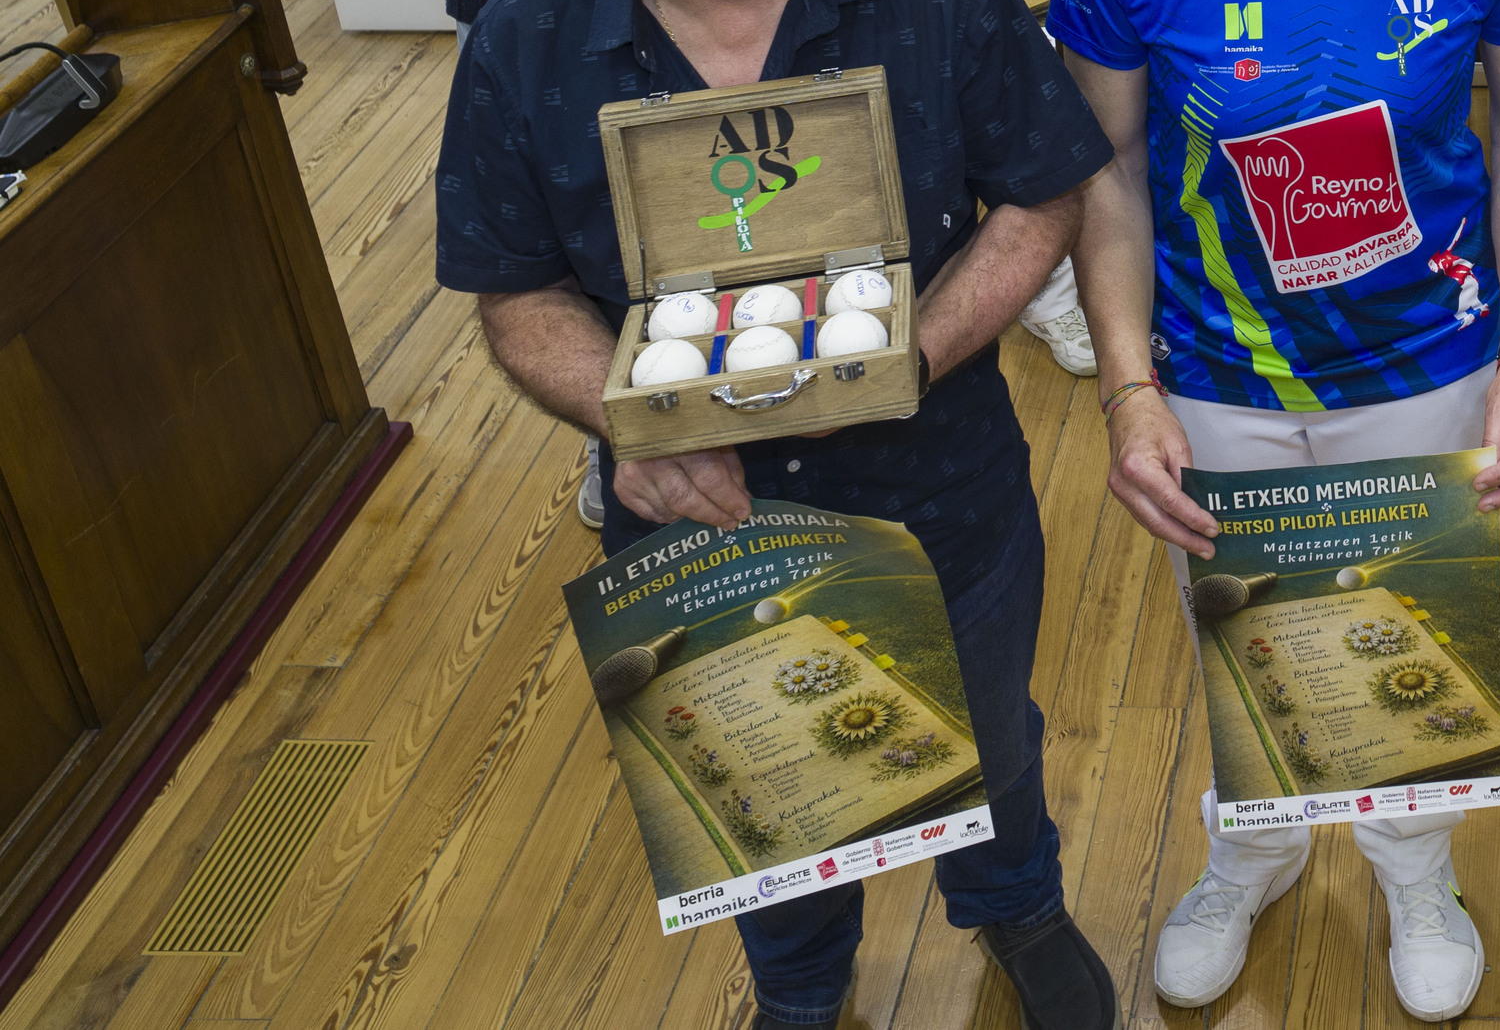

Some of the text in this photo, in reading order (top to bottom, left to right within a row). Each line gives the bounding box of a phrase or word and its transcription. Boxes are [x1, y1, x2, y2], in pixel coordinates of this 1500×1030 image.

[1224, 45, 1263, 53] hamaika
[1289, 174, 1402, 225] Gourmet
[1311, 174, 1384, 199] Reyno
[733, 196, 752, 251] PILOTA
[1277, 221, 1414, 277] CALIDAD NAVARRA
[1281, 233, 1420, 290] NAFAR KALITATEA
[1207, 472, 1438, 511] II. ETXEKO MEMORIALA
[1280, 513, 1337, 531] PILOTA
[1341, 502, 1429, 526] LEHIAKETA
[1263, 530, 1413, 553] Maiatzaren 1etik
[1278, 546, 1401, 564] Ekainaren 7ra
[597, 575, 621, 596] II.
[625, 529, 711, 581] ETXEKO
[604, 532, 848, 617] BERTSO PILOTA LEHIAKETA
[665, 551, 833, 607] Maiatzaren 1etik
[683, 565, 823, 614] Ekainaren 7ra
[662, 631, 792, 693] Zure irria hedatu dadin
[708, 663, 740, 680] hauen
[744, 647, 779, 664] artean
[693, 677, 750, 706] Mitxoletak
[724, 712, 783, 742] Bitxiloreak
[751, 749, 817, 784] Eguzkiloreak
[778, 785, 845, 822] Kukuprakak
[1236, 800, 1275, 813] berria
[1236, 813, 1304, 826] hamaika
[765, 868, 811, 887] EULATE
[679, 886, 724, 908] berria
[681, 893, 759, 926] hamaika
